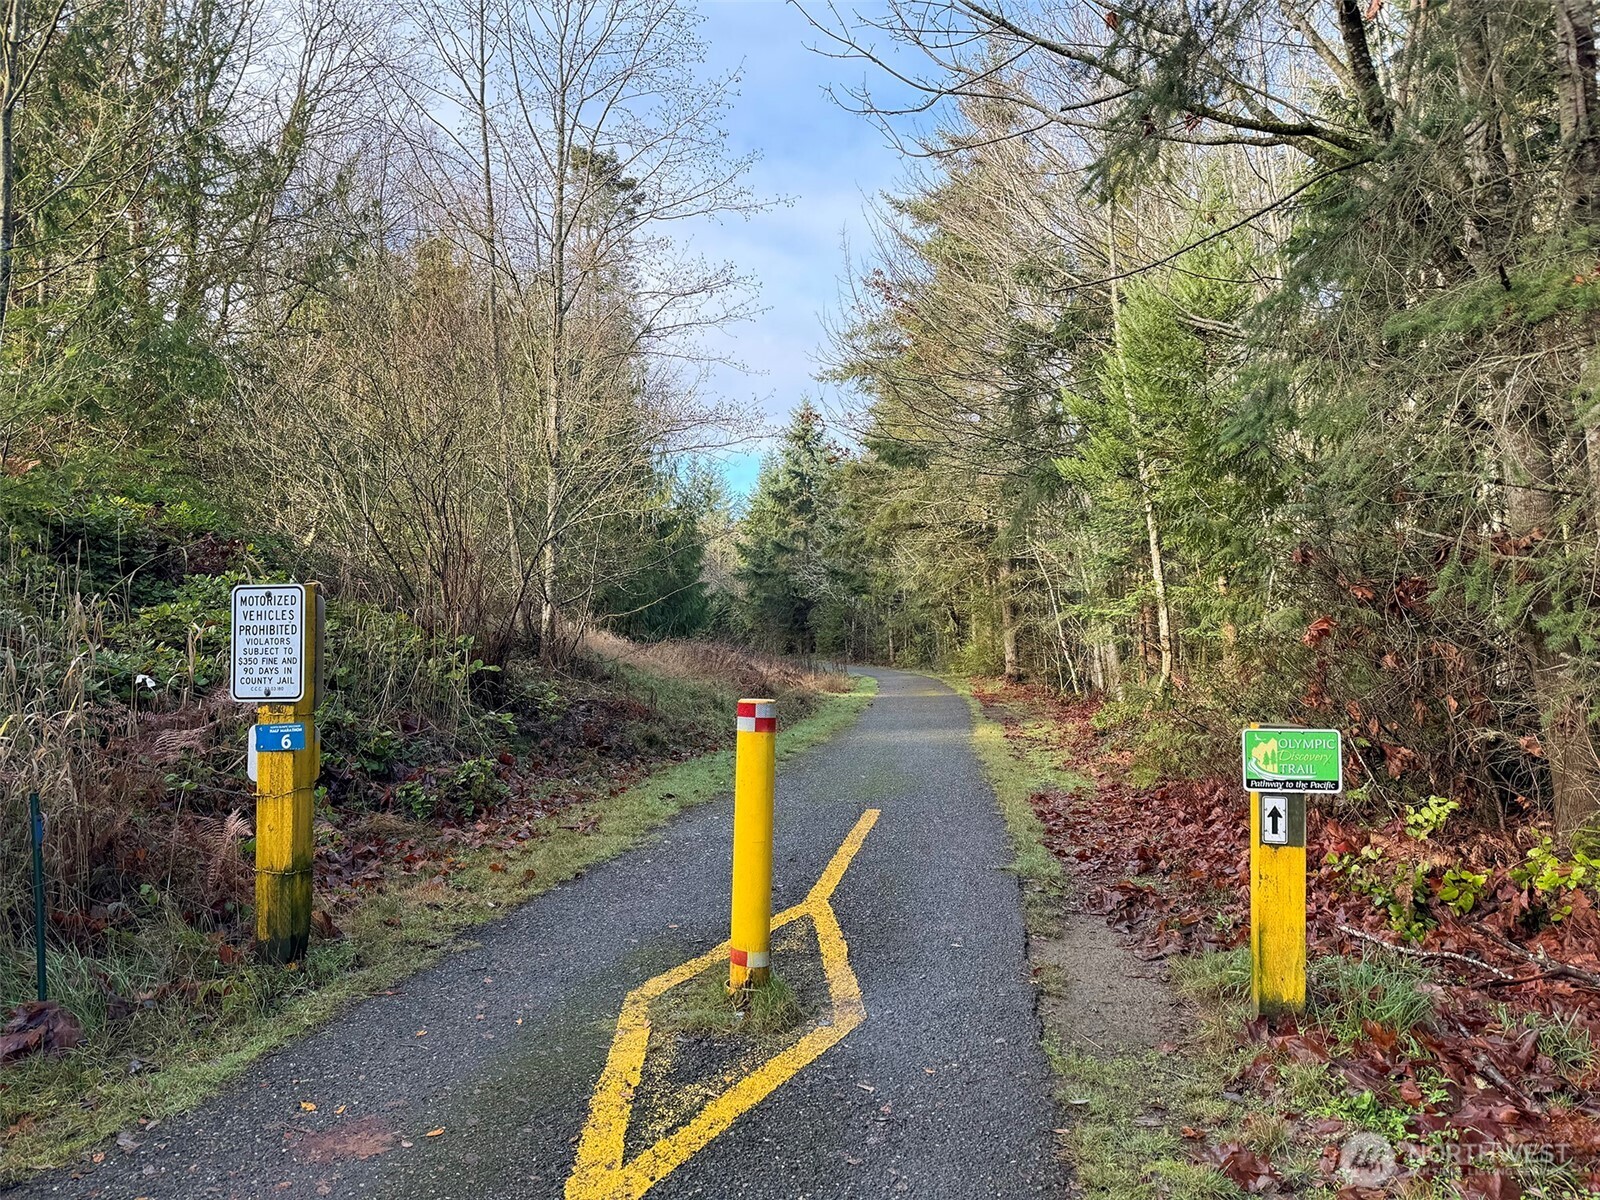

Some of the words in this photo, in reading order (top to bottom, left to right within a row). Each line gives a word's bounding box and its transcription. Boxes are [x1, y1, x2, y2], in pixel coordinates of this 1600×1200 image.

[240, 595, 297, 606] MOTORIZED
[242, 609, 295, 621] VEHICLES
[239, 624, 298, 636] PROHIBITED
[245, 637, 291, 645] VIOLATORS
[242, 647, 279, 655] SUBJECT
[284, 647, 294, 655] TO
[238, 657, 259, 666] $350
[261, 657, 278, 665] FINE
[281, 657, 298, 665] AND
[243, 667, 254, 675] 90
[258, 667, 279, 675] DAYS
[283, 667, 293, 675] IN
[239, 677, 273, 685] COUNTY
[281, 734, 292, 749] 6
[1278, 738, 1335, 749] OLYMPIC
[1277, 749, 1333, 766] Discovery
[1279, 763, 1316, 774] TRAIL
[1250, 780, 1284, 790] Pathway
[1310, 781, 1336, 790] Pacific
